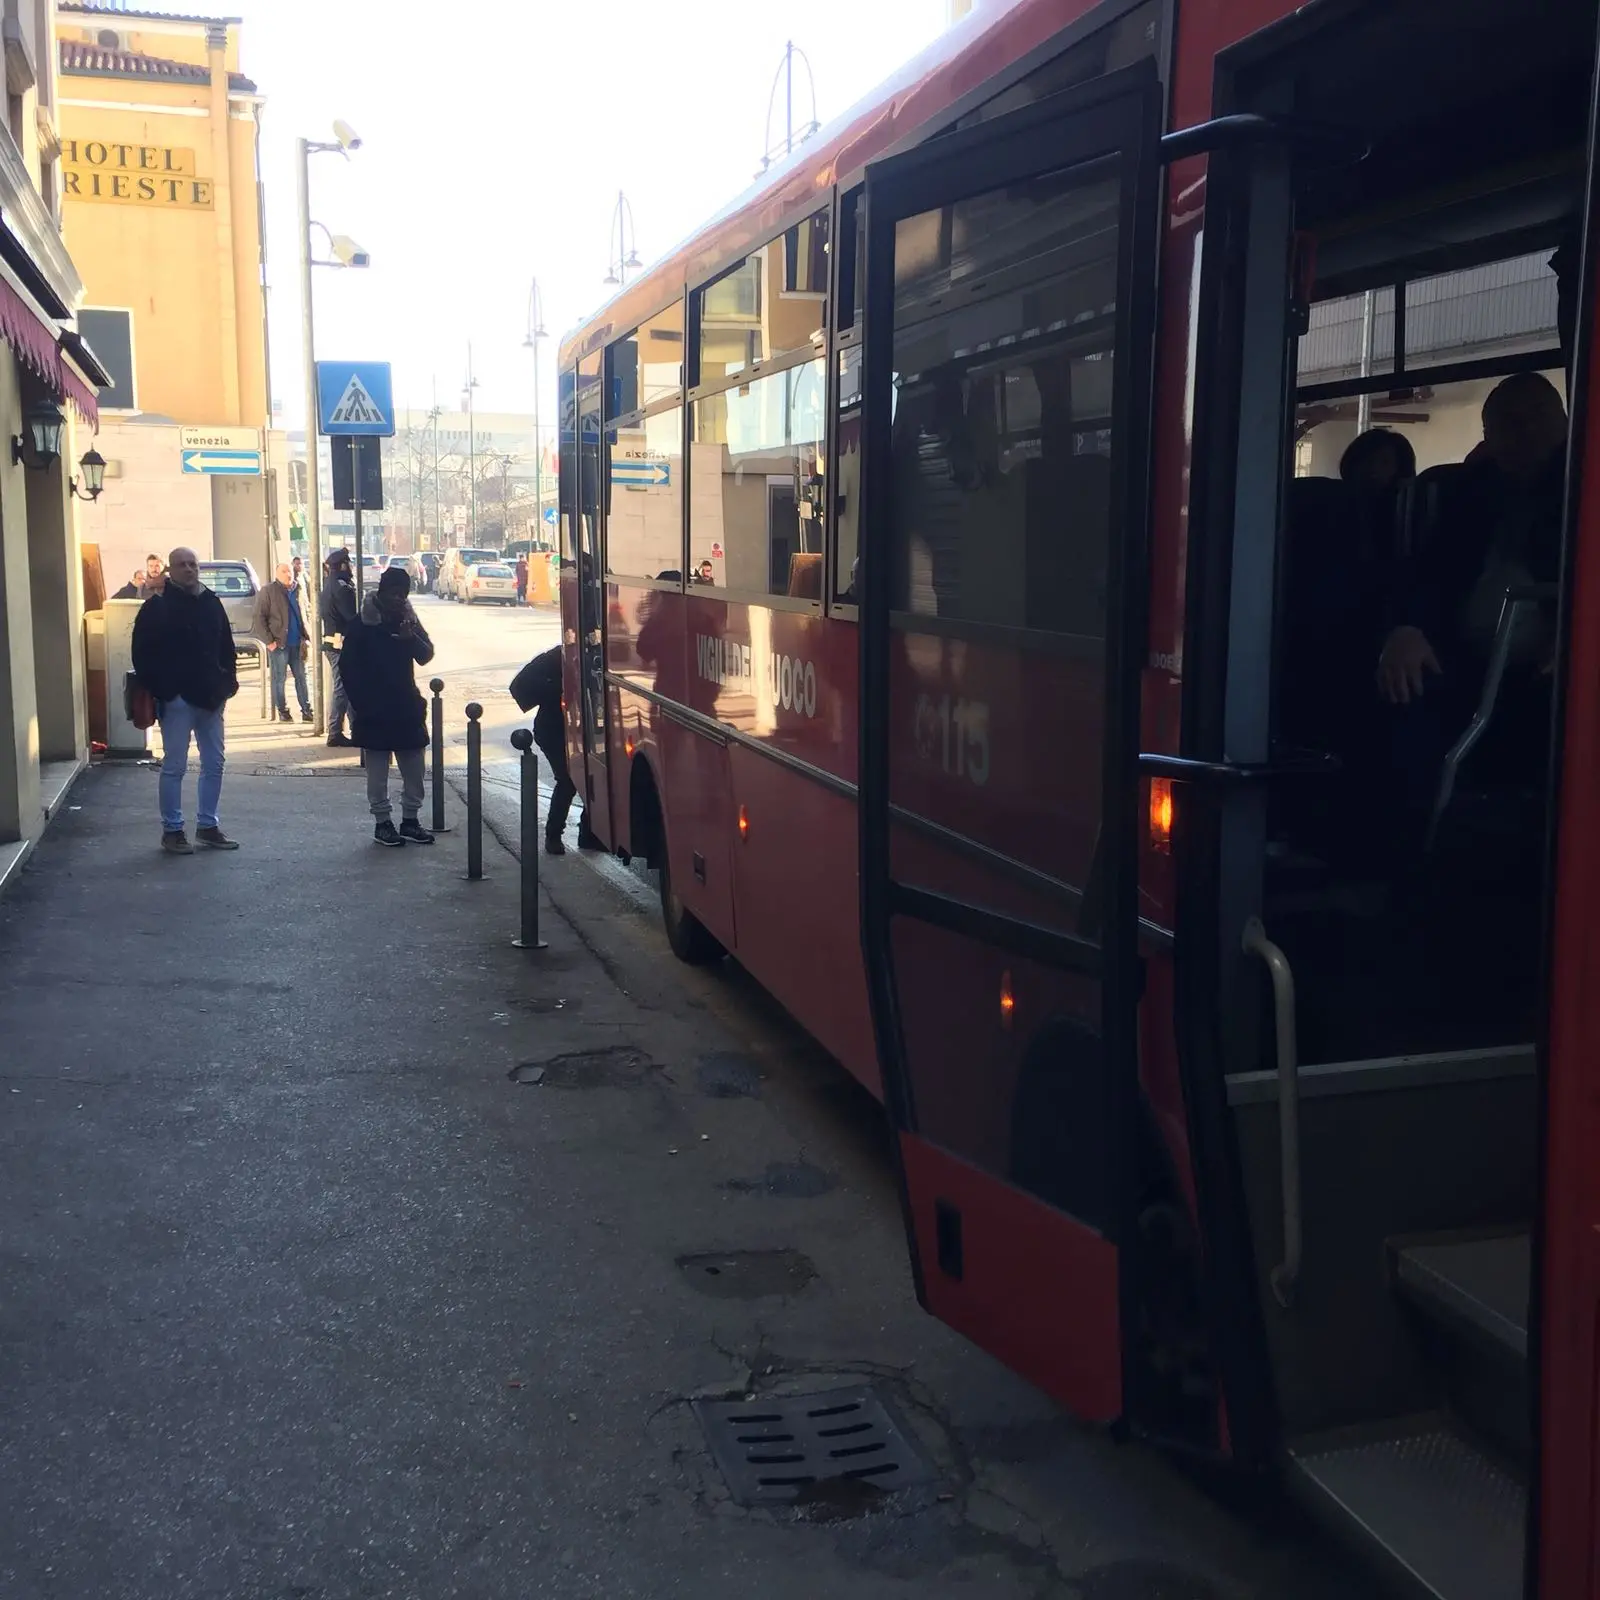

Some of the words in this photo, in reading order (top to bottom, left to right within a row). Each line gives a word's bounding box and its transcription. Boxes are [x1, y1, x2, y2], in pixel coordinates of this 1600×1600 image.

[61, 140, 183, 172] HOTEL
[63, 171, 211, 205] RIESTE
[186, 436, 230, 446] venezia
[765, 650, 816, 719] UOCO
